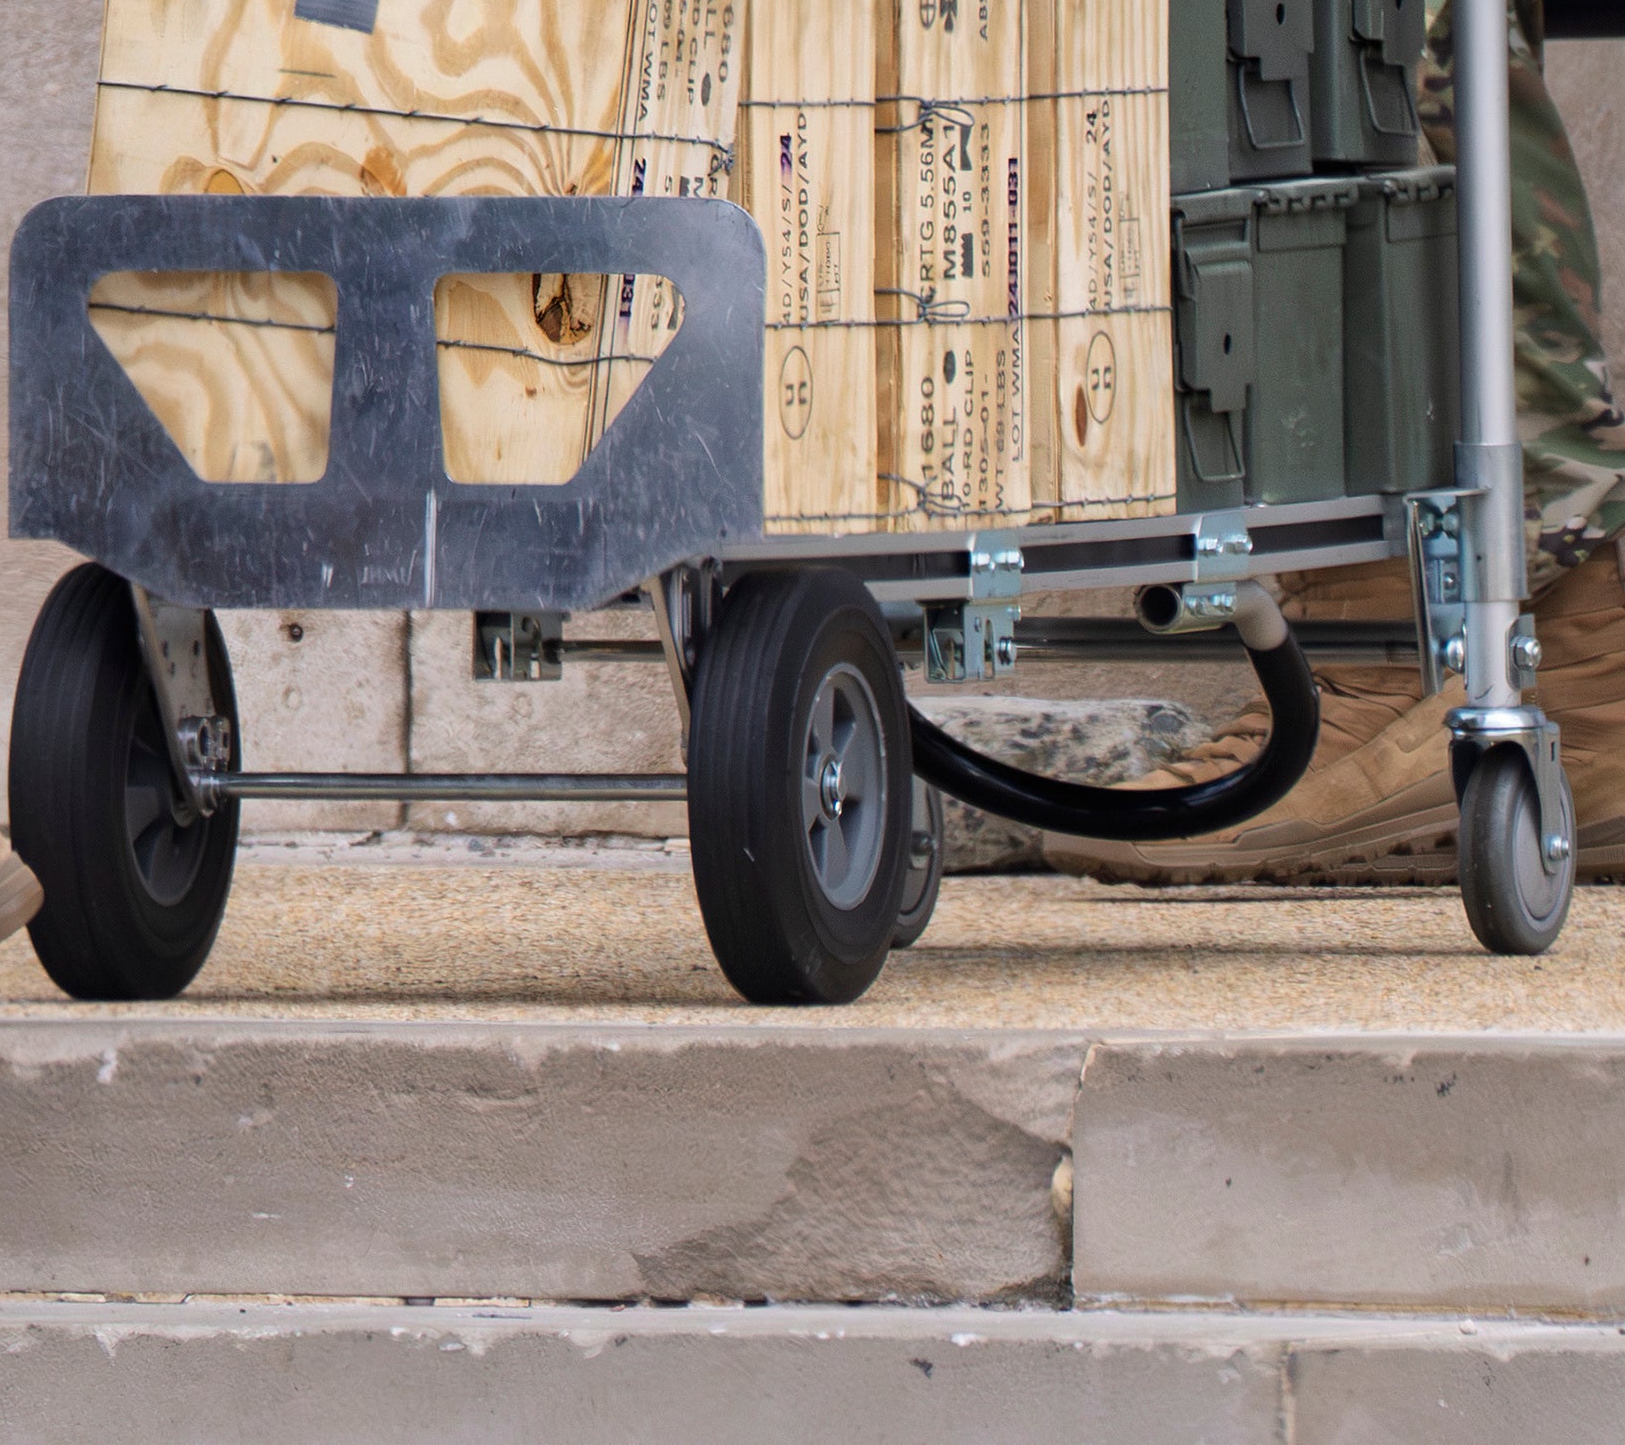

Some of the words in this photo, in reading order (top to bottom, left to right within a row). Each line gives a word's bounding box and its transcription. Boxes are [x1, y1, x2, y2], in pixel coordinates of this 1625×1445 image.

[638, 52, 653, 122] WMA
[656, 41, 670, 102] LBS
[687, 37, 698, 106] CLIP
[1085, 110, 1098, 144] 24
[942, 124, 957, 280] M855A1
[962, 190, 973, 213] 10
[979, 122, 991, 278] 559-3333
[963, 349, 974, 417] CLIP
[1011, 326, 1020, 397] WMA
[941, 405, 956, 501] BALL
[1011, 410, 1021, 463] LOT
